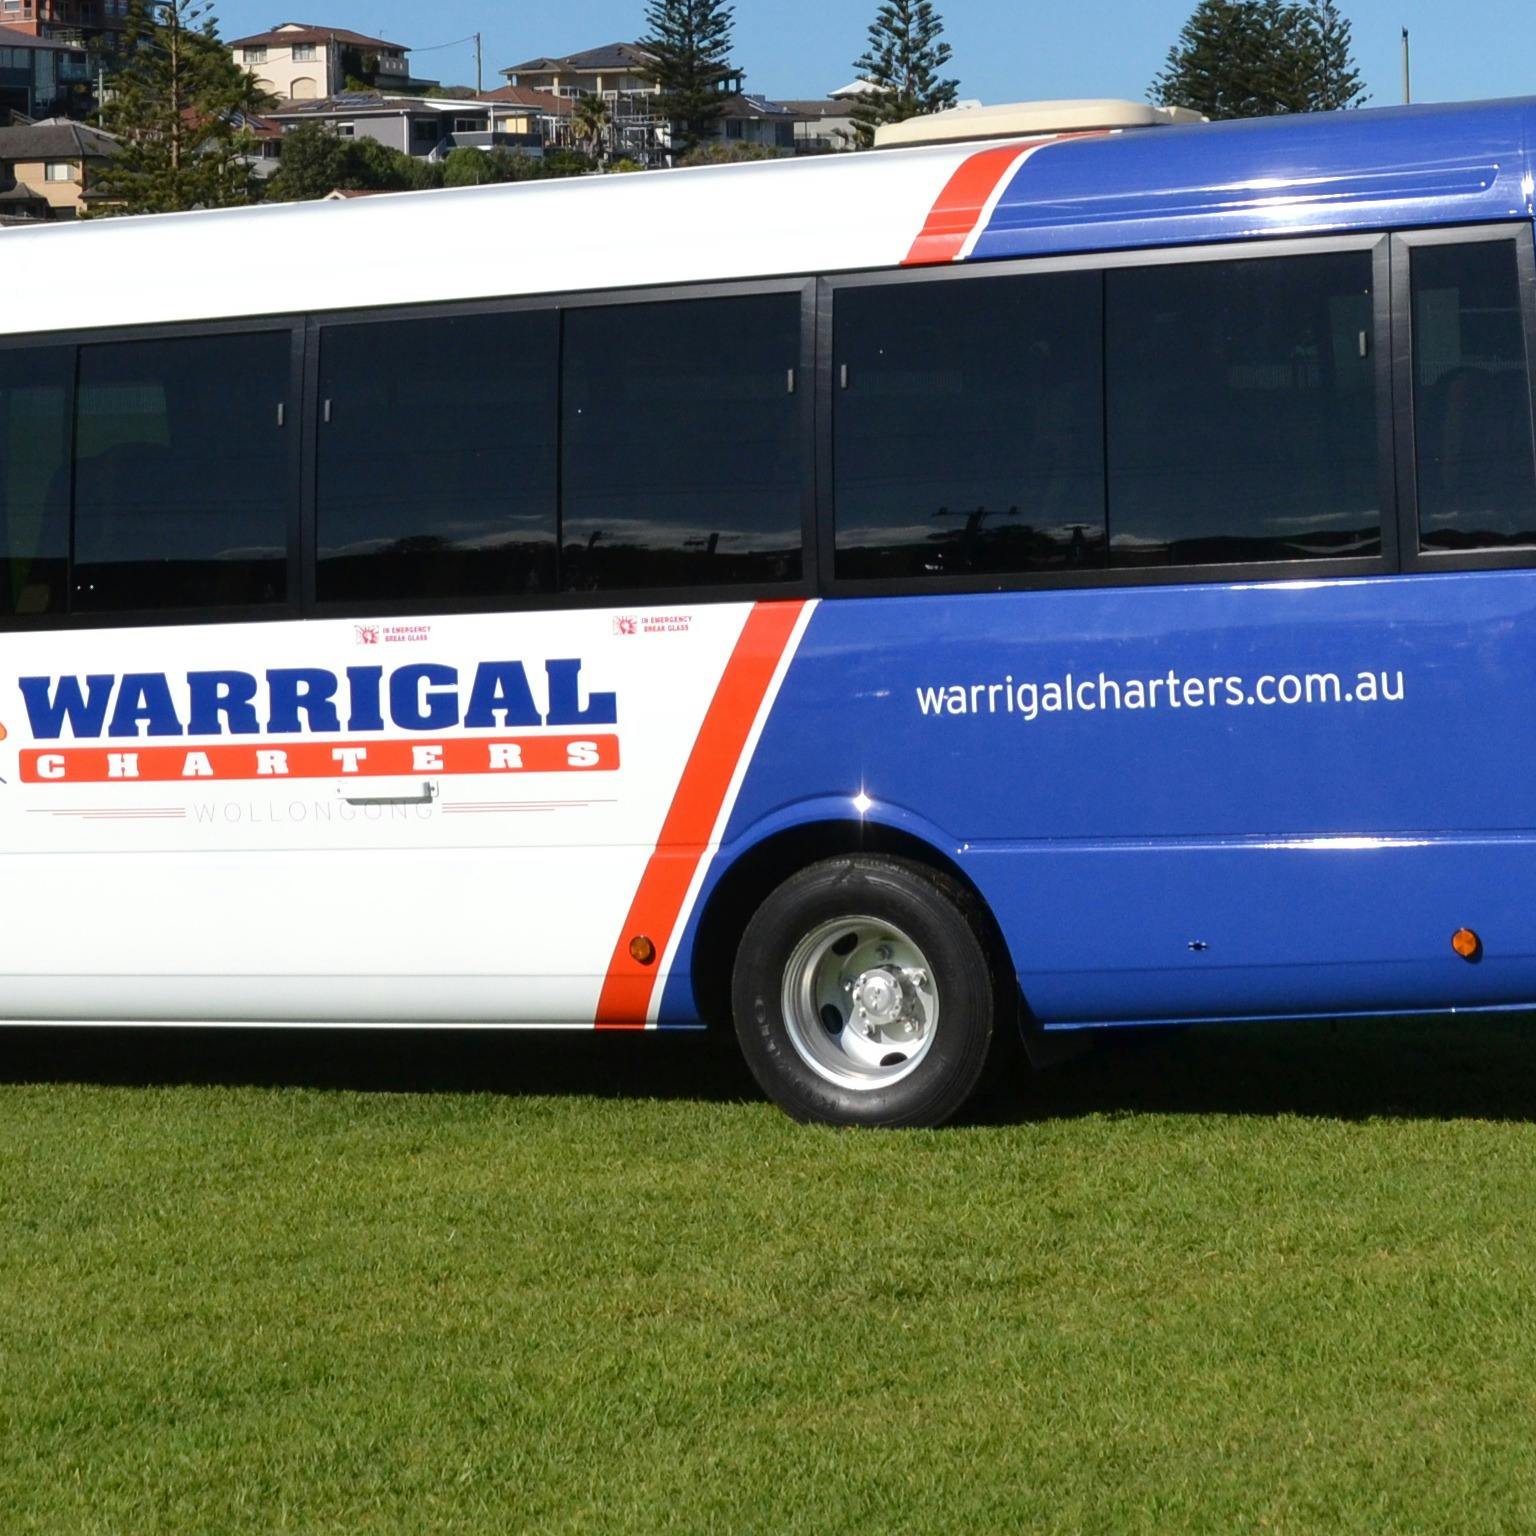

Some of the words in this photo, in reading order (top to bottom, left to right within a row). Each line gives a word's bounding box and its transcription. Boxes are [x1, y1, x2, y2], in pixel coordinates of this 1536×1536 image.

[651, 616, 693, 624] EMERGENCY
[19, 658, 617, 739] WARRIGAL
[916, 669, 1405, 721] warrigalcharters.com.au
[35, 739, 600, 779] CHARTERS
[194, 800, 433, 823] WOLLONGONG
